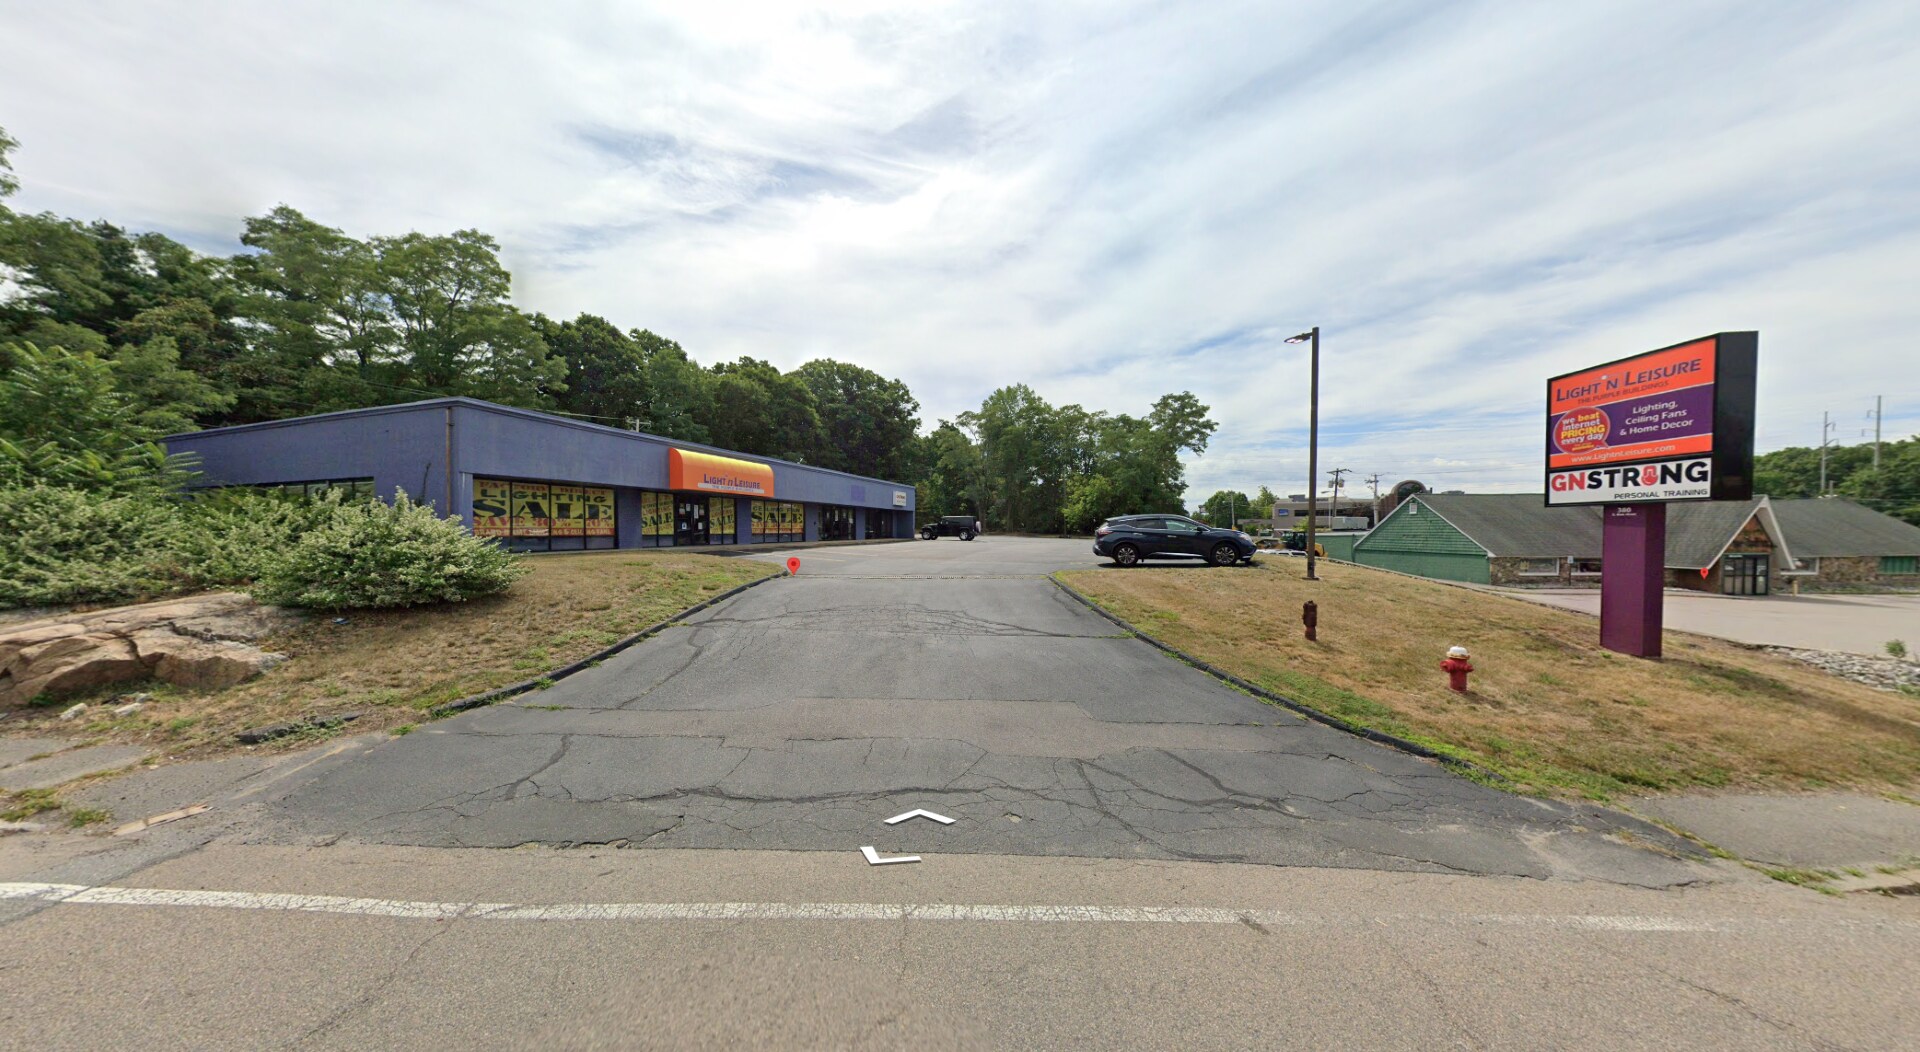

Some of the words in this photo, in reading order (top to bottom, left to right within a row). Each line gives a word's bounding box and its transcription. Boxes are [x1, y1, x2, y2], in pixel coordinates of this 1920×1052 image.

[1556, 383, 1601, 402] LIGHT
[1624, 359, 1702, 386] LEISURE
[1632, 401, 1678, 415] Lighting,
[1562, 417, 1576, 425] we
[1578, 411, 1600, 422] beat
[1625, 413, 1659, 425] Ceiling
[1661, 409, 1687, 419] Fans
[1562, 418, 1601, 431] internet
[1629, 424, 1660, 435] Home
[1661, 419, 1694, 430] Decor
[1561, 425, 1605, 439] PRICING
[1561, 436, 1585, 445] every
[1586, 433, 1604, 442] day
[703, 474, 726, 485] LIGHT
[734, 477, 761, 489] LEISURE
[480, 489, 607, 503] LIGHTING
[1614, 491, 1660, 499] PERSONAL
[1663, 488, 1708, 497] TRAINING
[473, 498, 613, 520] SALE
[473, 516, 526, 527] SAVE
[641, 512, 673, 529] SALE
[751, 511, 803, 524] SALE
